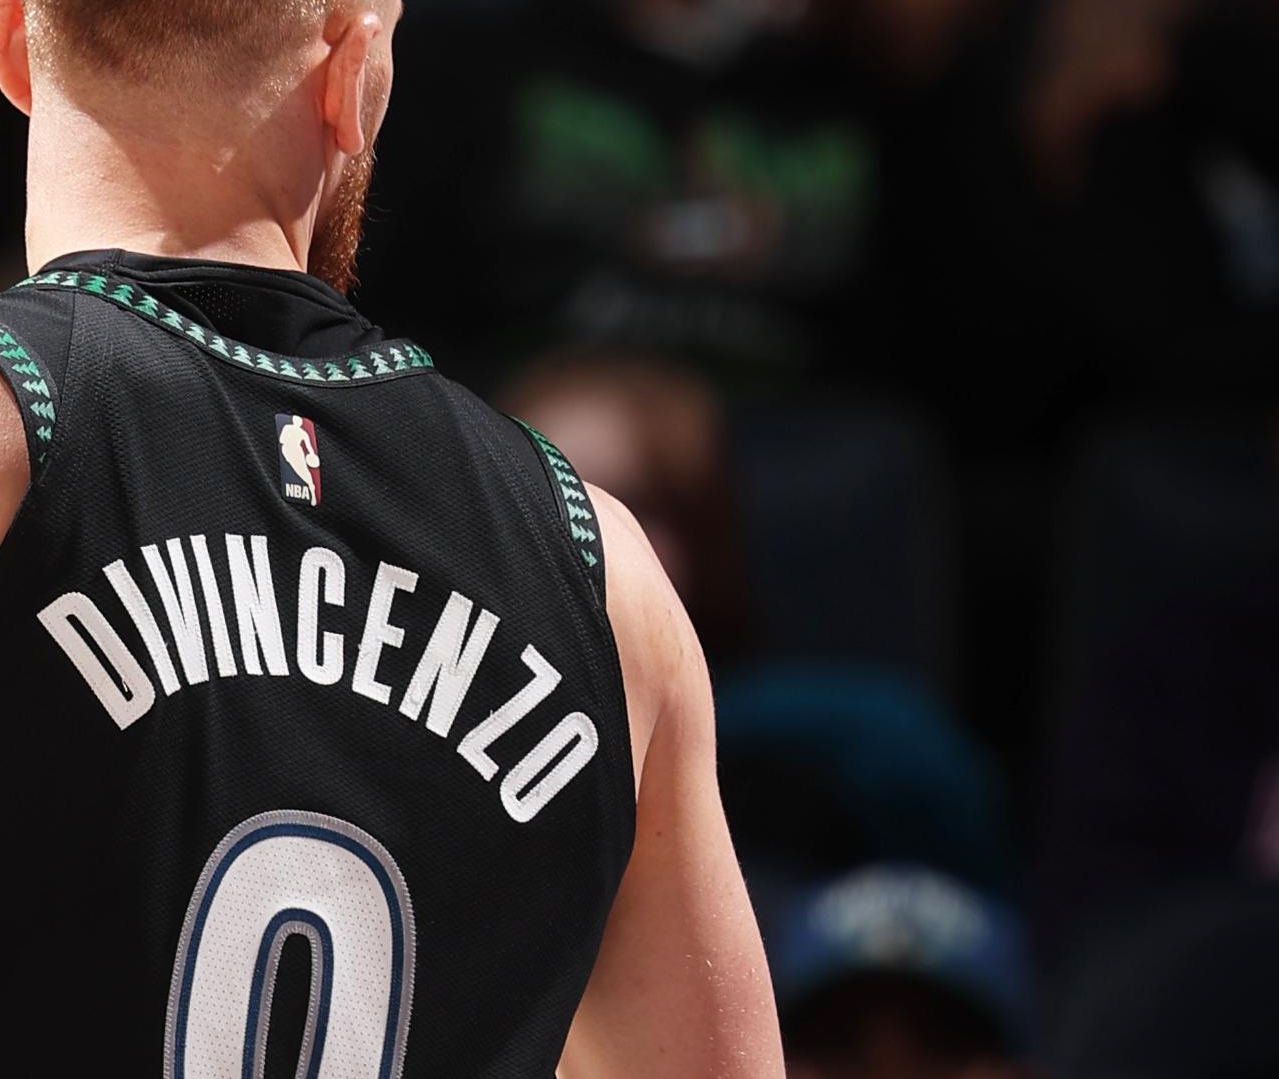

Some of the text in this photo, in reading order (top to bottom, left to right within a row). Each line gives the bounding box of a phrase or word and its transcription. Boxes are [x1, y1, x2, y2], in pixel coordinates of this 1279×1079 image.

[285, 482, 311, 501] NBA
[36, 532, 600, 824] DIVINCENZO
[162, 808, 417, 1079] 0
